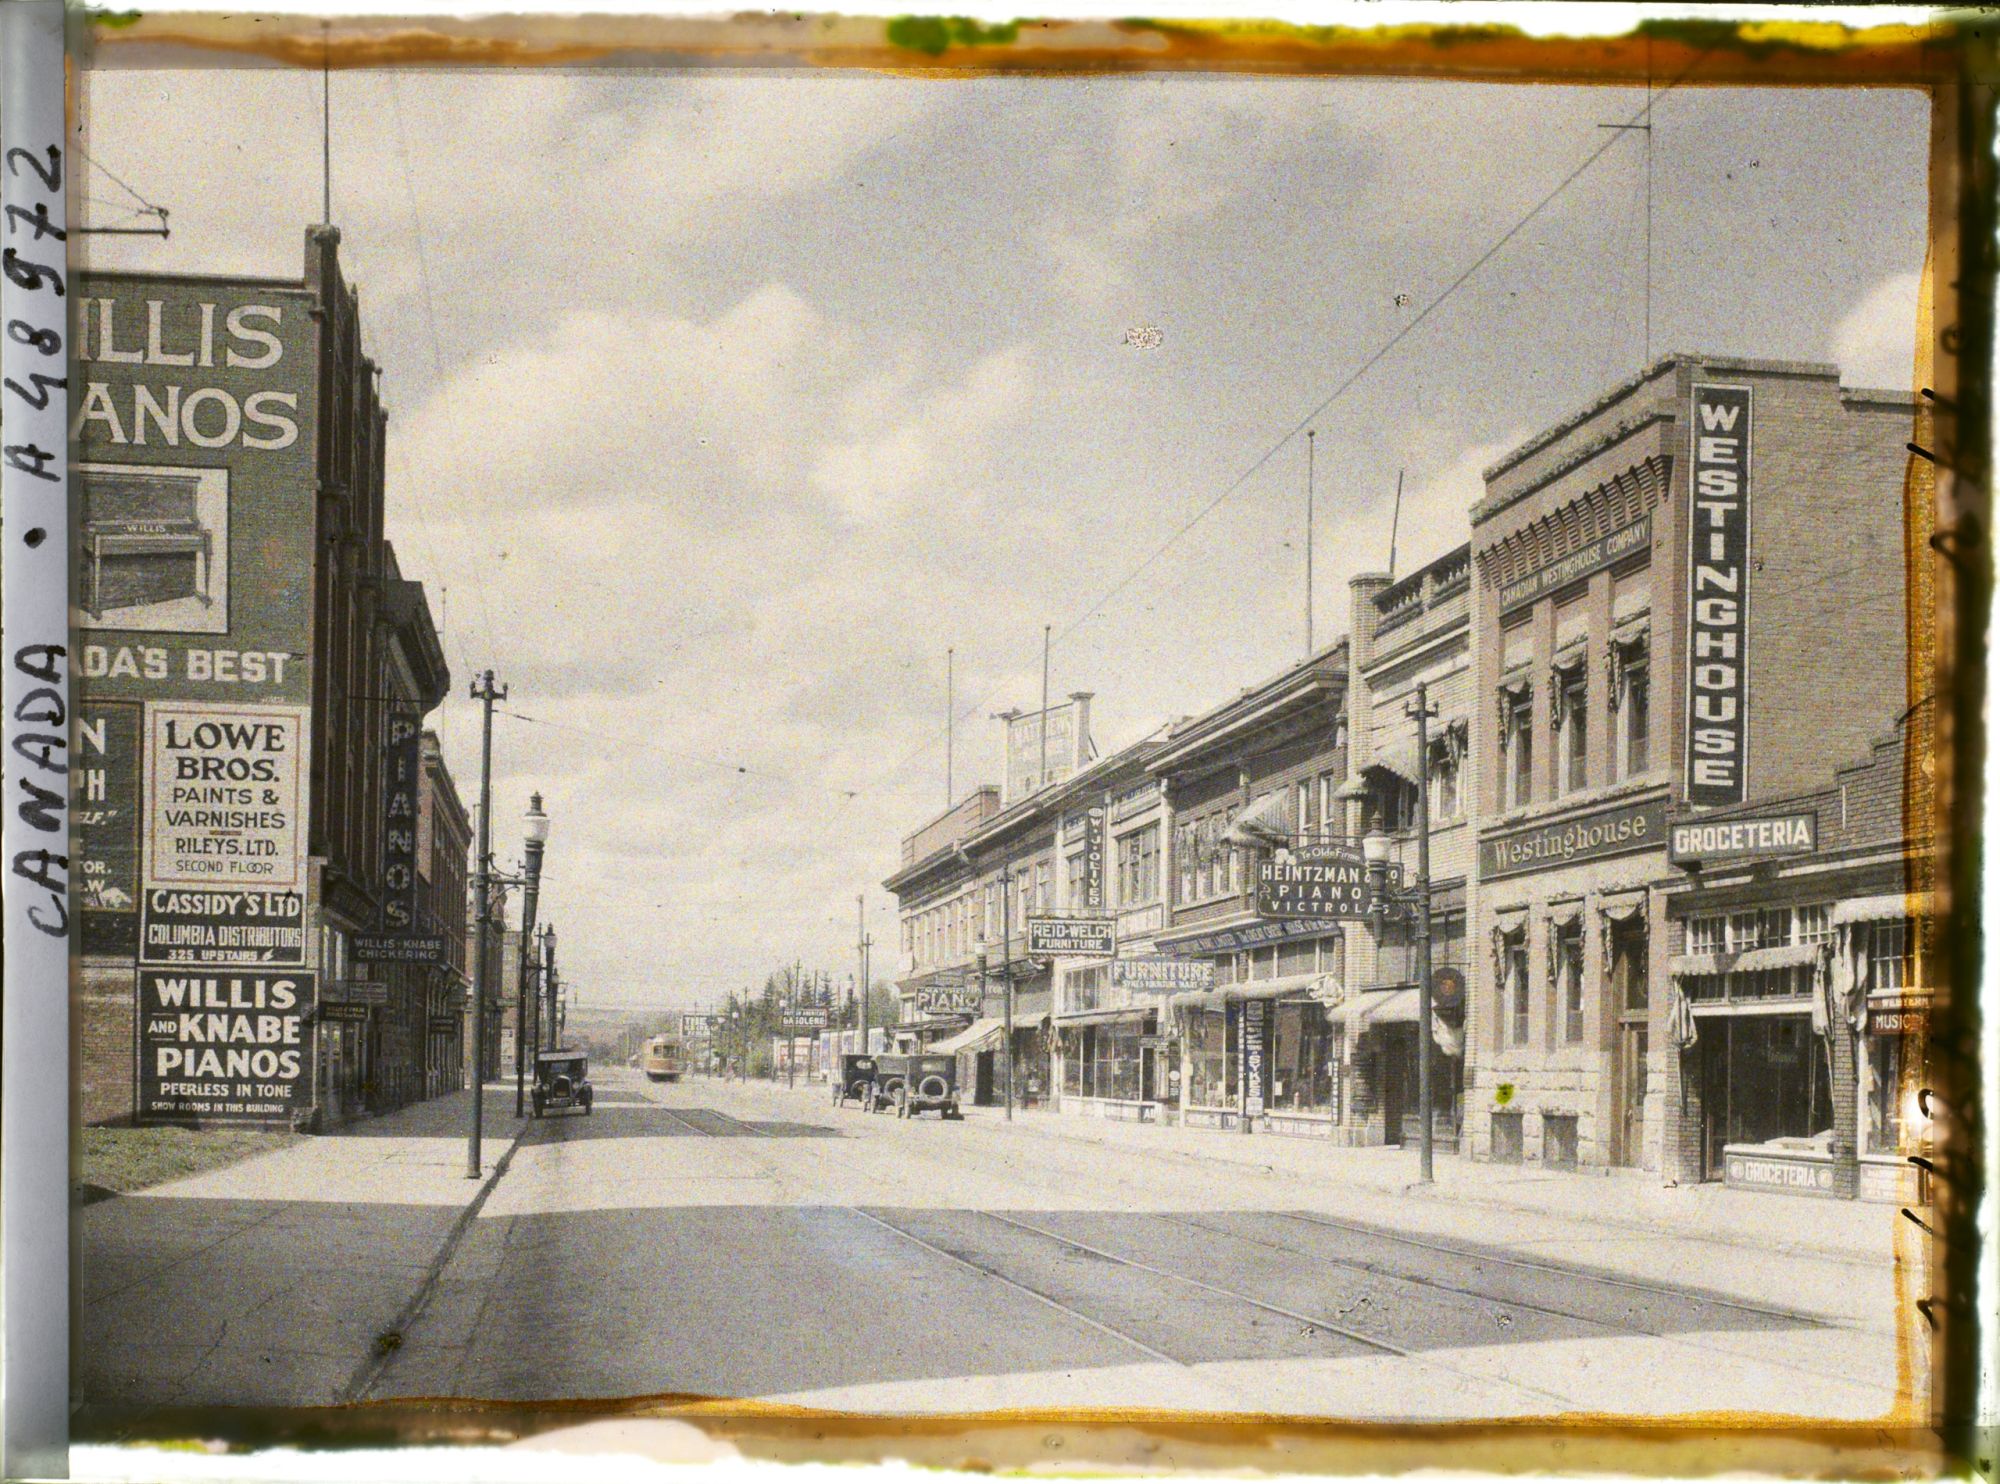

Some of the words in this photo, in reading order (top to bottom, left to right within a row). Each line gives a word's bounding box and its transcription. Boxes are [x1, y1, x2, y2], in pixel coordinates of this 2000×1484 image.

[3, 441, 62, 482] A
[126, 524, 167, 533] WILLIS
[1541, 543, 1601, 588] WESTINGHOUSE
[1606, 522, 1648, 555] COMPANY
[1694, 403, 1740, 787] WESTINGHOUSE
[186, 649, 293, 684] BEST
[165, 719, 286, 752] LOWE
[175, 756, 281, 783] BROS.
[12, 644, 69, 938] CANADA
[173, 787, 252, 805] PAINTS
[262, 789, 280, 805] &
[165, 810, 286, 829] VARNISHES
[386, 719, 415, 927] PIANOS
[1493, 813, 1648, 871] Westinghouse
[1674, 818, 1812, 855] GROCETERIA
[1300, 850, 1311, 860] Ye
[1312, 847, 1335, 857] Olde
[176, 860, 223, 873] SECOND
[230, 861, 274, 875] FLOOR
[1261, 864, 1360, 883] HEINTZMAN
[151, 889, 261, 916] CASSIDY'S
[264, 892, 300, 917] LTD
[148, 923, 216, 947] COLUMBIA
[218, 926, 302, 948] DISTRIBUTORS
[1033, 924, 1112, 938] REID-WELCH
[168, 949, 194, 961] 325
[201, 950, 258, 962] UPSTAIRS
[354, 938, 395, 948] WILLIS
[403, 939, 442, 950] KNABE
[358, 949, 438, 960] CHICKERING
[1038, 938, 1103, 950] FURNITURE
[1113, 960, 1214, 982] FURNITURE
[154, 978, 297, 1010] WILLIS
[148, 1020, 178, 1034] AND
[179, 1013, 301, 1044] KNABE
[1875, 1013, 1911, 1031] MUSIC
[156, 1047, 301, 1079] PIANOS
[160, 1082, 229, 1096] PEERLESS
[236, 1083, 252, 1097] IN
[256, 1084, 293, 1098] TONE
[151, 1102, 175, 1111] SHOW
[178, 1102, 211, 1112] ROOMS
[213, 1102, 223, 1112] IN
[225, 1103, 244, 1113] THIS
[246, 1103, 285, 1114] BUILDING
[1744, 1161, 1818, 1188] GROCETERIA
